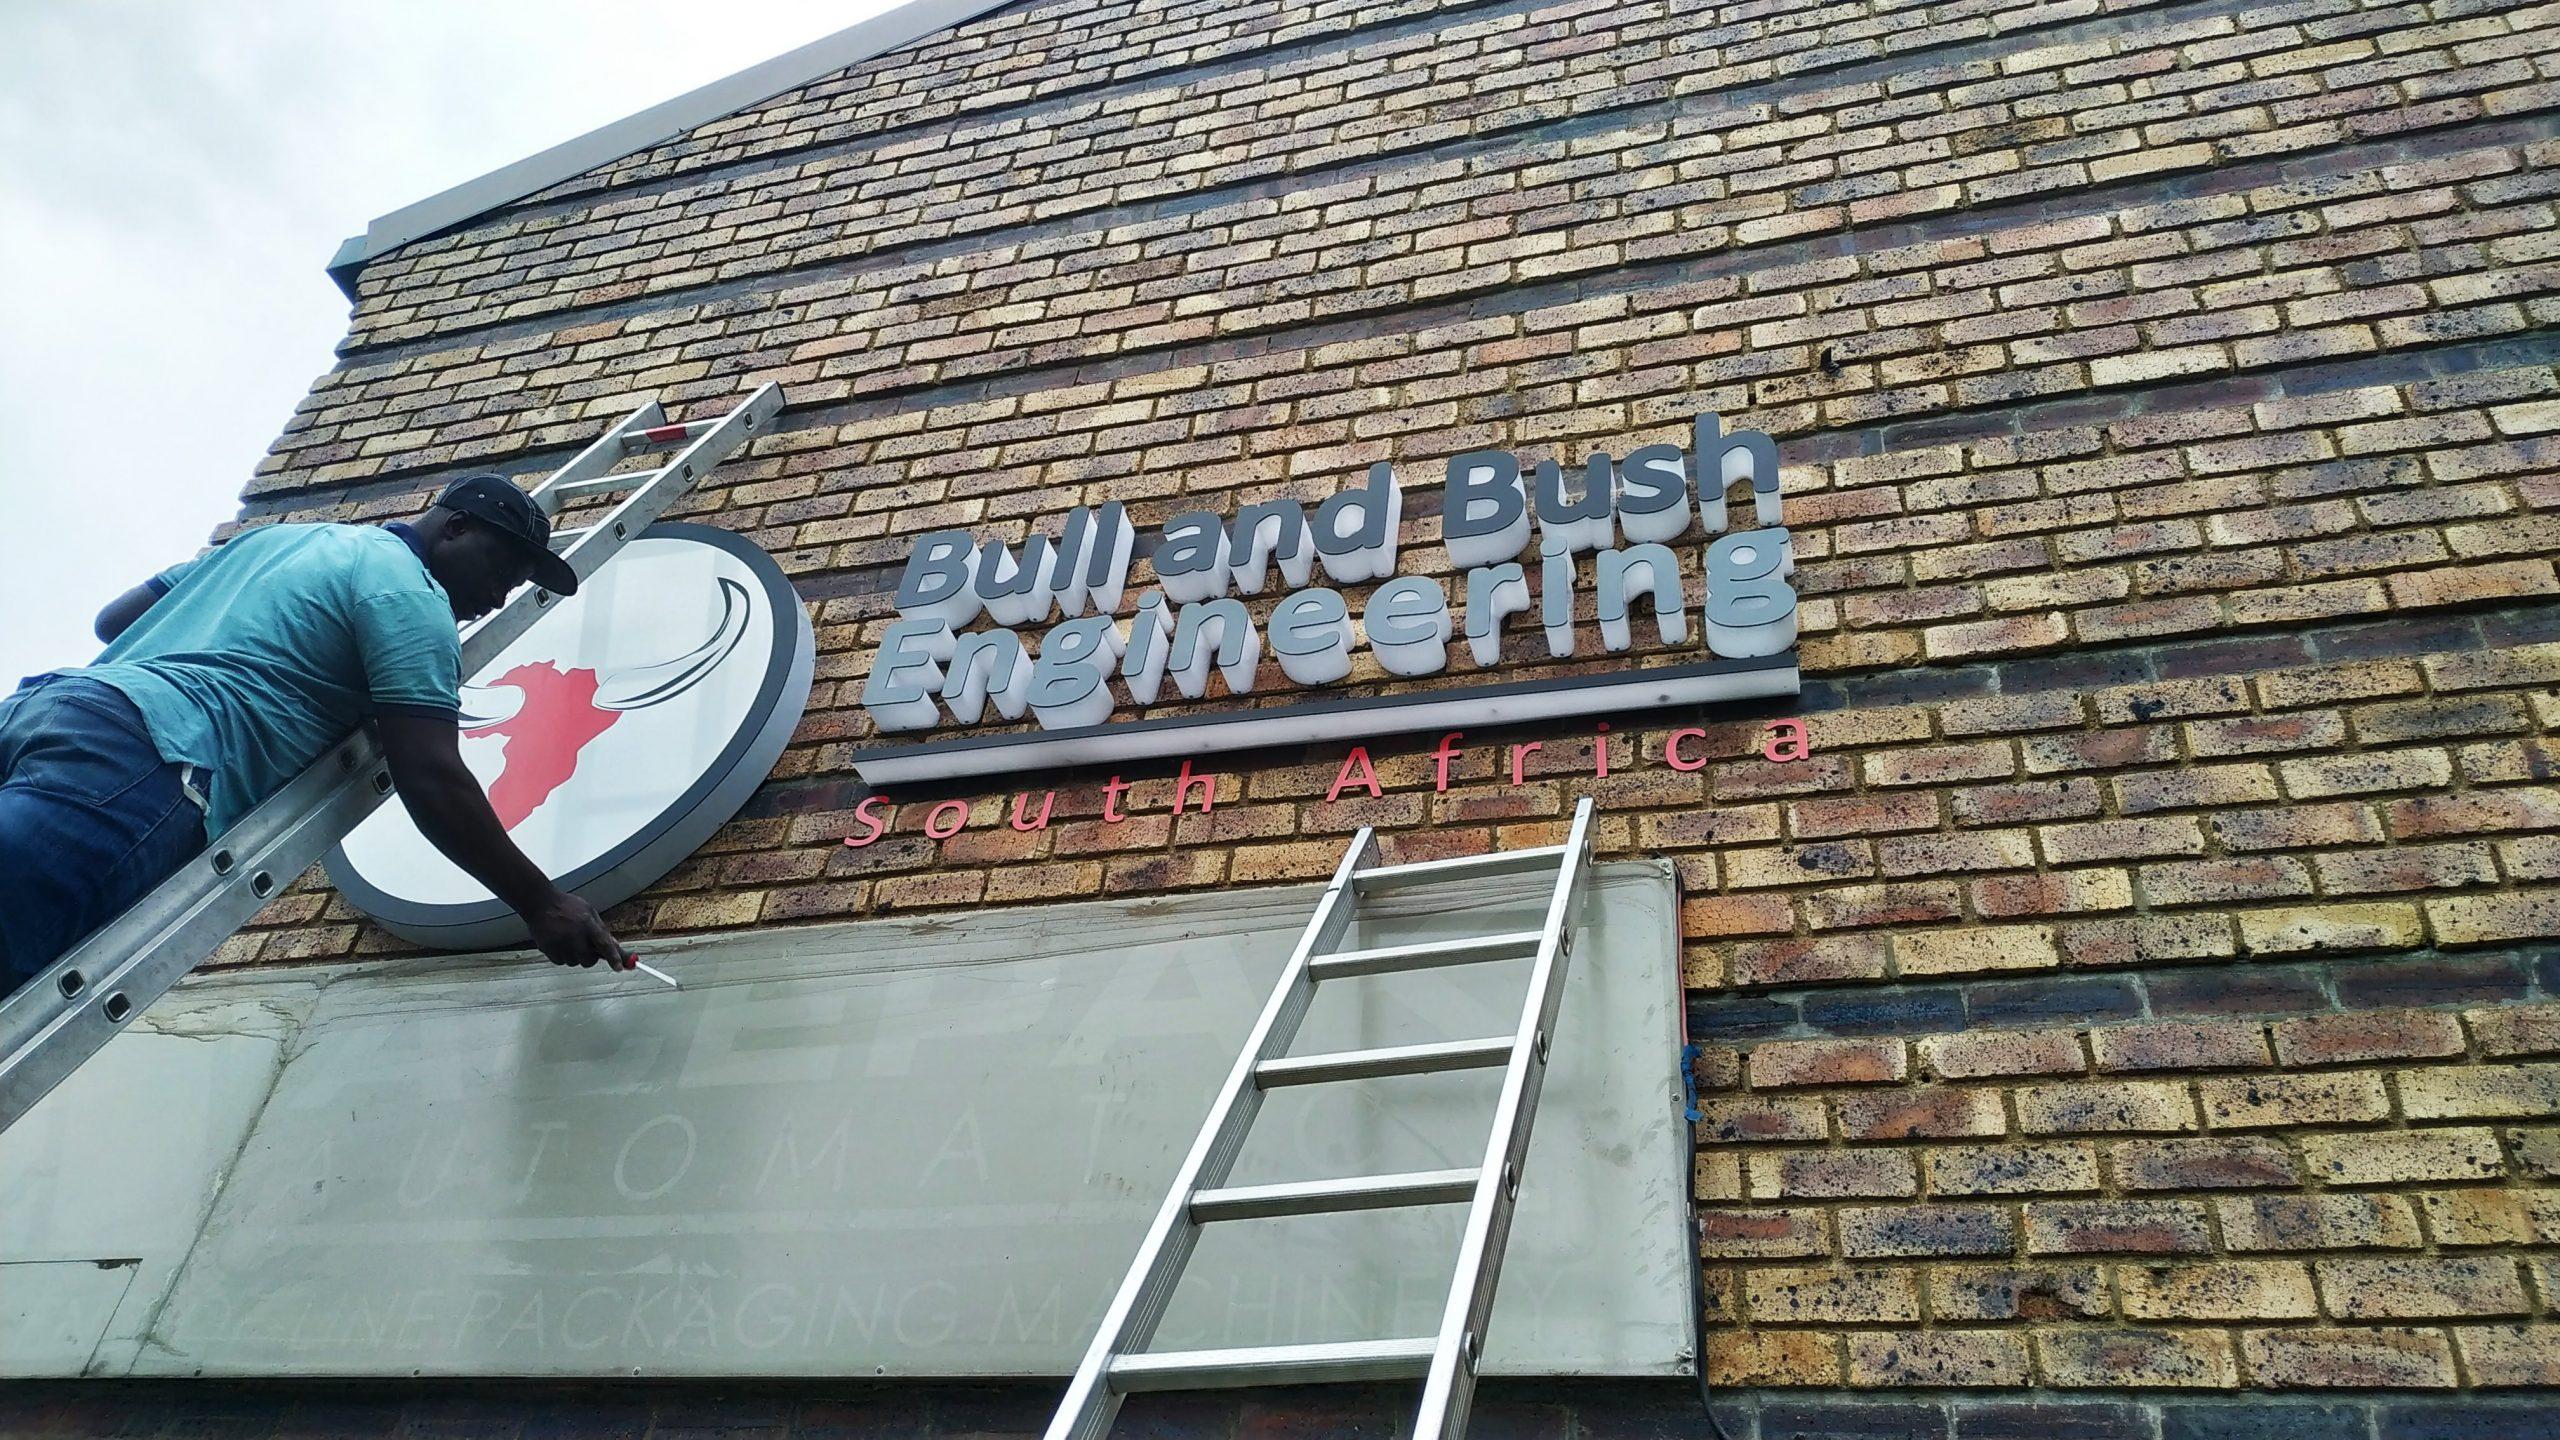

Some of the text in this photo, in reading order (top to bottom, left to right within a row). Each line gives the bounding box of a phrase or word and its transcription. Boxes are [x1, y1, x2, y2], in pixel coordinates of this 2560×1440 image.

[896, 412, 1783, 628] Bull and Bush
[861, 527, 1798, 731] Engineering
[844, 716, 1811, 848] South Africa
[985, 1266, 1566, 1346] MACHINEY
